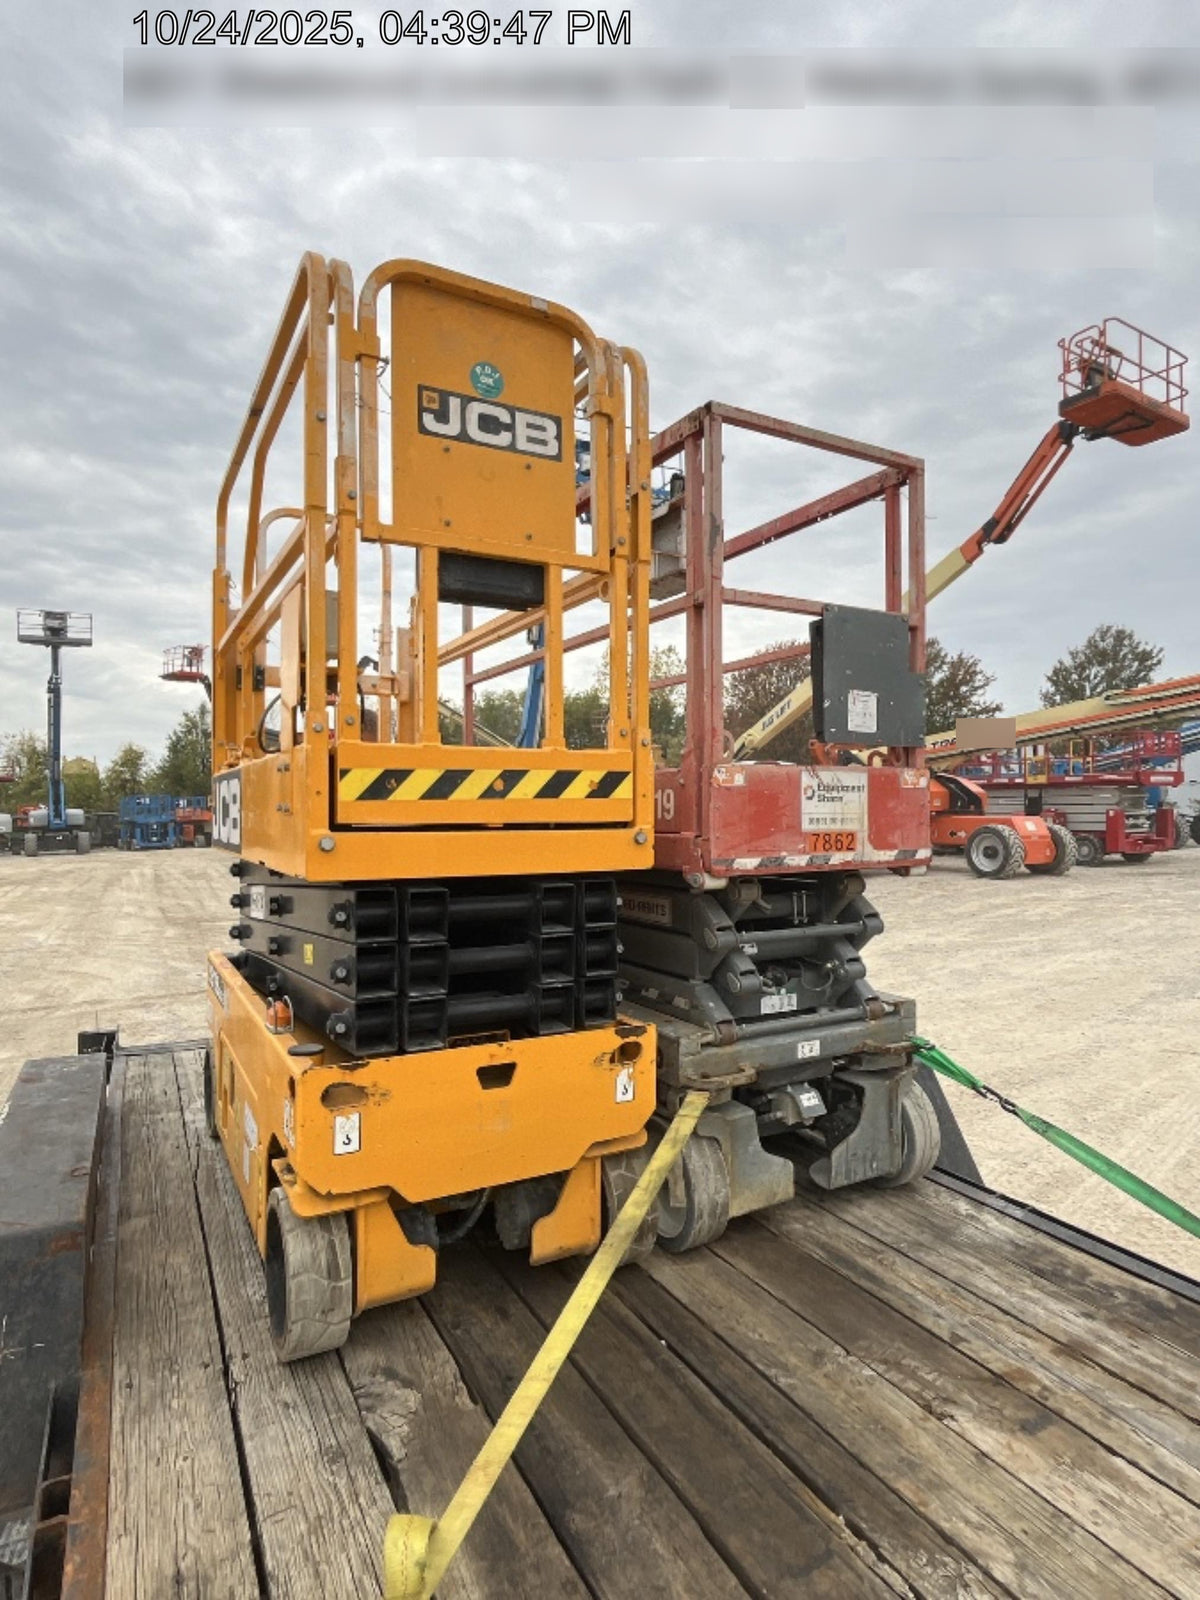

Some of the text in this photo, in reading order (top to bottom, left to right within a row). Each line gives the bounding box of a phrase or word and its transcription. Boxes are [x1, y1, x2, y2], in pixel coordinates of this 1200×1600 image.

[422, 396, 559, 456] JCB
[655, 789, 675, 820] 19
[811, 833, 855, 852] 7862
